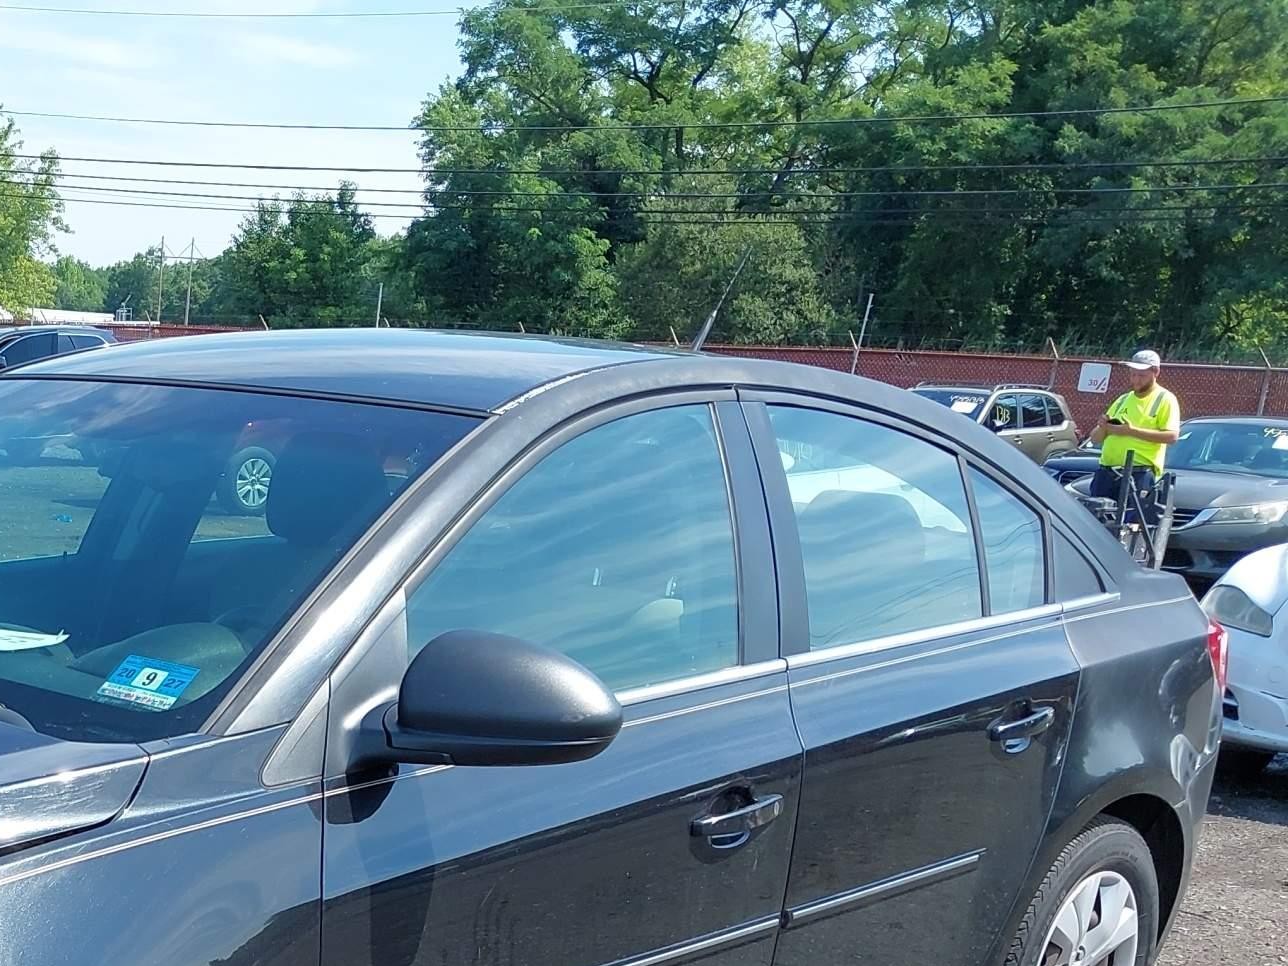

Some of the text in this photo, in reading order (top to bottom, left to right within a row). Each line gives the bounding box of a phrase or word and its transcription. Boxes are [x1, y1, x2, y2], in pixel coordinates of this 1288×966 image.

[117, 667, 187, 690] 20 9 27
